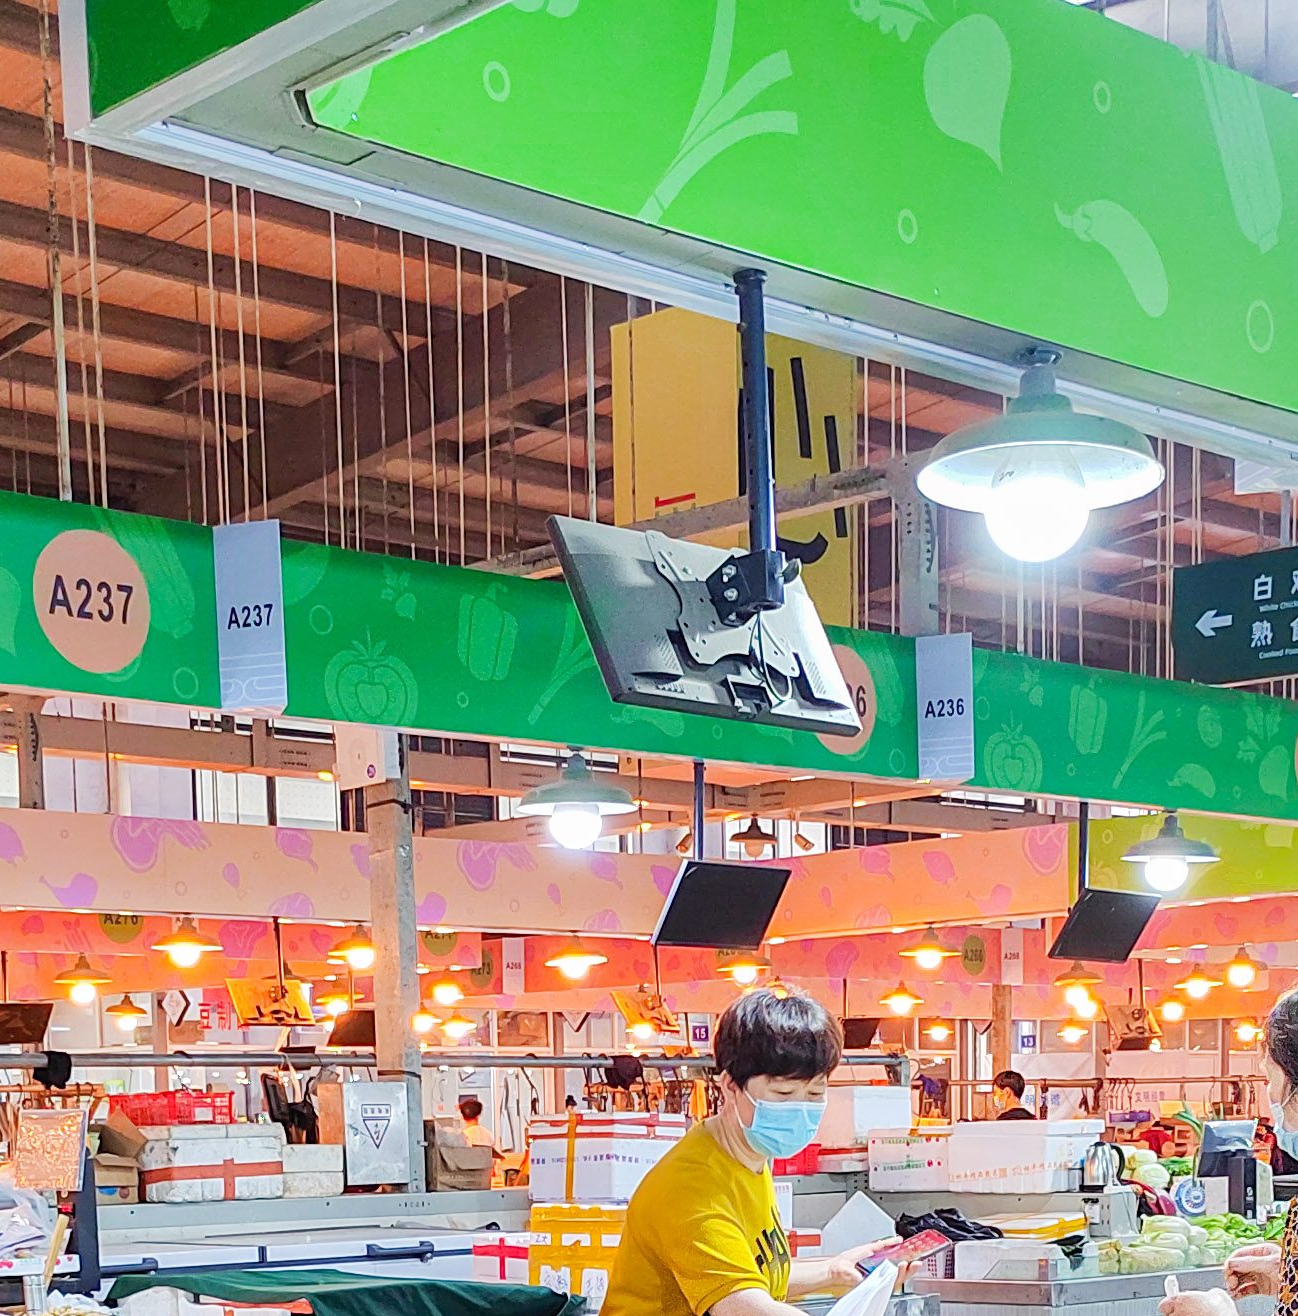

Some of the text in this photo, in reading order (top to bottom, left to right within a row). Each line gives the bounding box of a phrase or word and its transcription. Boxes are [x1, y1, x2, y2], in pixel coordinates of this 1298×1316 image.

[48, 574, 134, 625] A237
[227, 603, 274, 630] A237
[924, 698, 965, 718] A236
[694, 1027, 706, 1039] 15
[1023, 1037, 1034, 1047] 13
